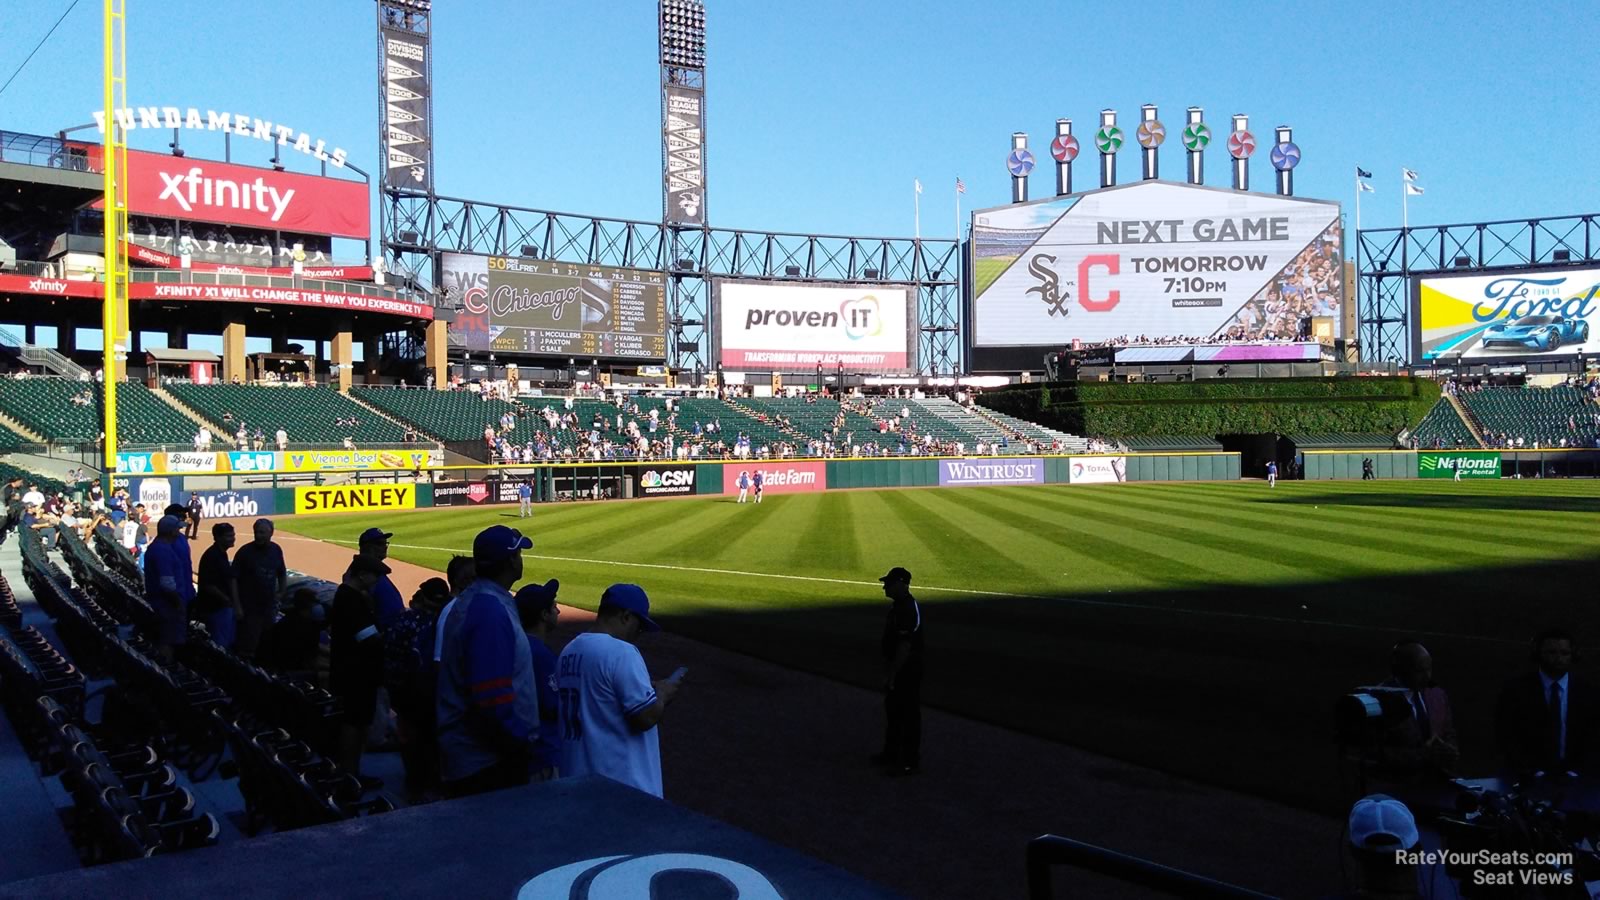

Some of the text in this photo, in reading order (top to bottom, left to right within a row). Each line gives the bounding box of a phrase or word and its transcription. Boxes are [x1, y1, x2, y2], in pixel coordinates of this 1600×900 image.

[388, 43, 423, 56] DIVISION
[388, 50, 423, 62] CHAMPIONS
[670, 95, 698, 104] AMERICAN
[670, 100, 699, 110] LEAGUE
[390, 110, 412, 120] 2000
[92, 106, 348, 168] FUNDAMENTALS
[158, 167, 295, 222] xfinity
[1097, 217, 1289, 244] NEXT GAME
[489, 257, 506, 270] 50
[506, 264, 538, 273] PELFREY
[1131, 255, 1268, 273] TOMORROW
[29, 278, 68, 293] xfinity
[1078, 254, 1120, 312] C
[1164, 276, 1226, 294] 7:10PM
[156, 286, 422, 314] XFINITY X1 WILL CHANGE THE WAY YOU EXPERIENCE TV
[492, 284, 580, 320] Chicago
[1472, 277, 1600, 322] Ford
[745, 308, 871, 330] proven IT
[744, 352, 885, 364] TRANSFORMING WORKPLACE PRODUCTIVITY
[170, 454, 213, 467] Bring it
[311, 453, 377, 463] Vienna Beef
[662, 470, 694, 486] CSN
[947, 462, 1036, 480] WINTRUST
[113, 478, 129, 487] 330
[434, 484, 486, 497] guaranteed Rate
[199, 496, 258, 518] Modelo
[304, 487, 408, 510] STANLEY
[561, 653, 583, 678] BELL
